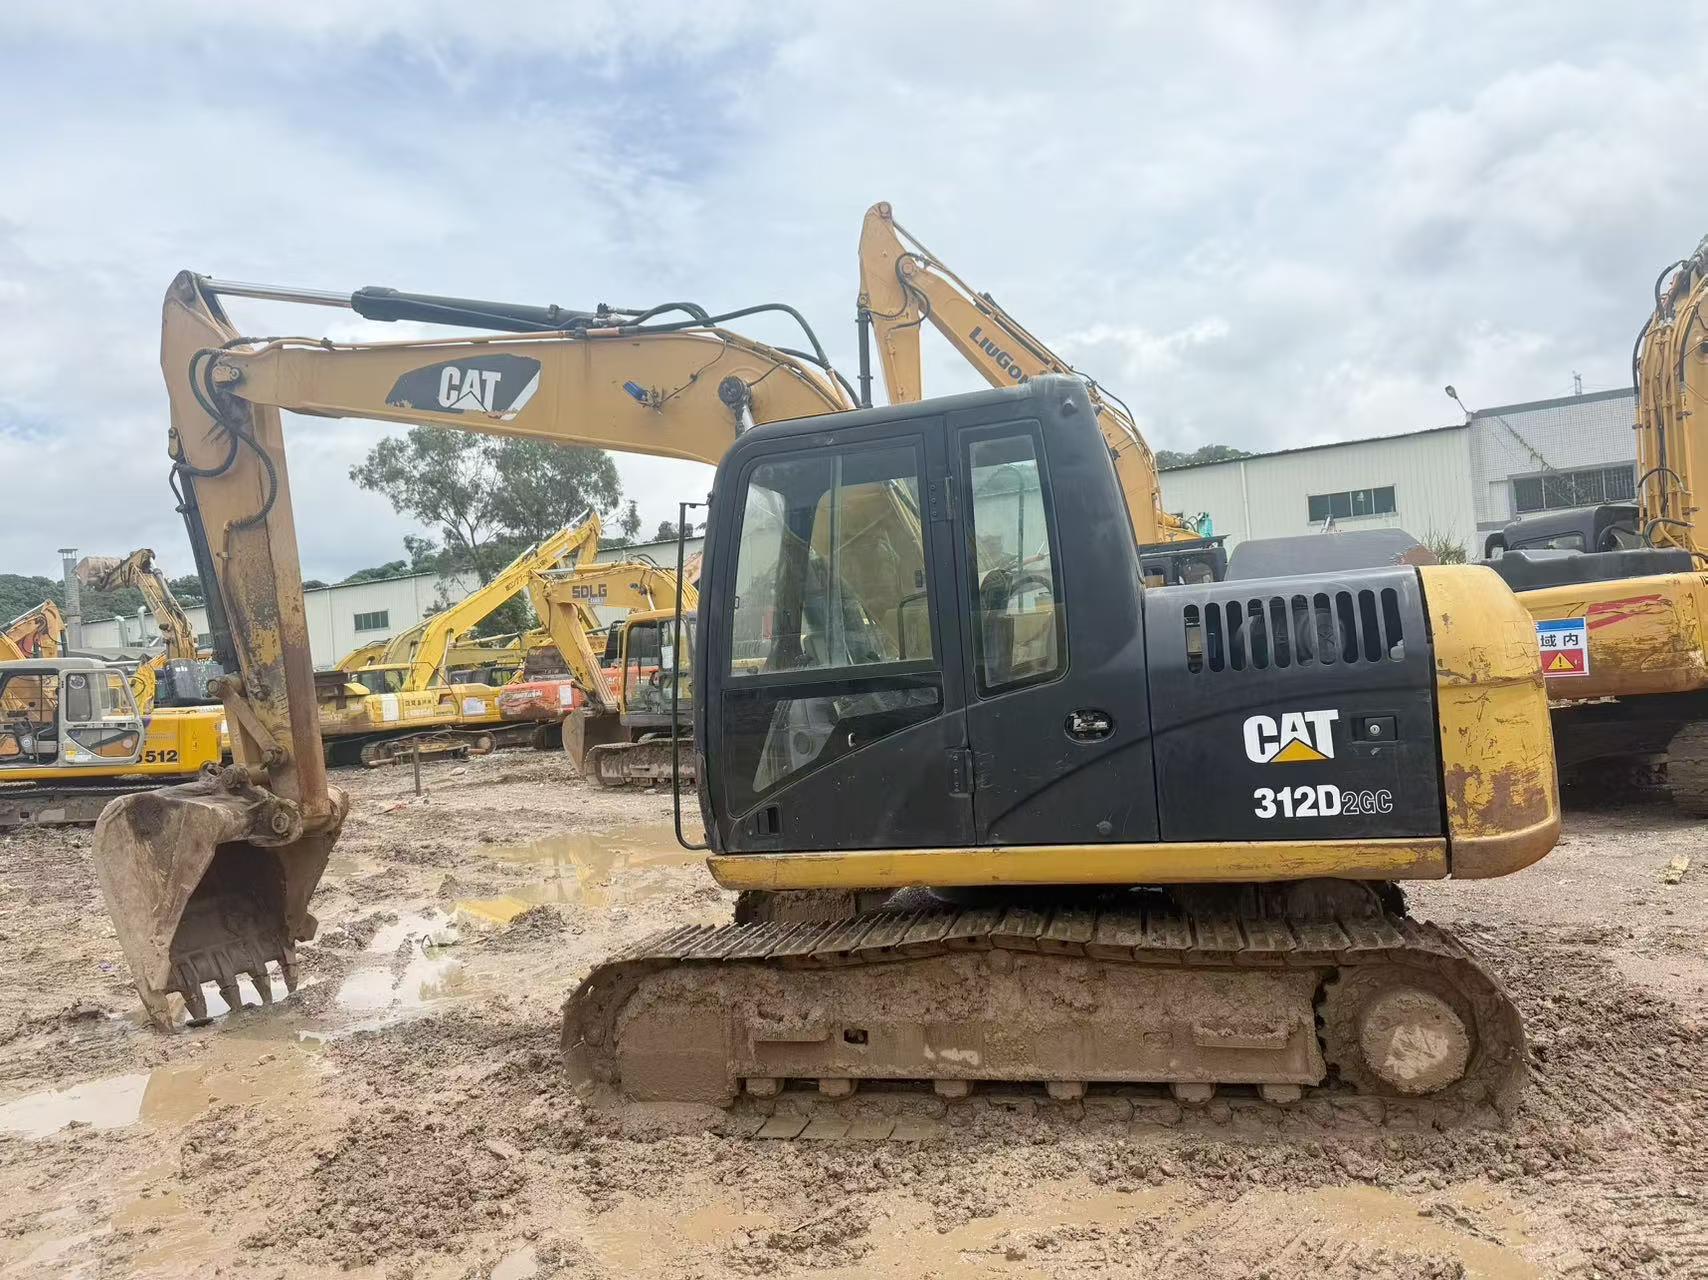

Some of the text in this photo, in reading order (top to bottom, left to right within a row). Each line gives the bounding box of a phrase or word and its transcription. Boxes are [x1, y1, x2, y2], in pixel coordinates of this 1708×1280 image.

[438, 366, 502, 412] CAT
[572, 583, 608, 599] SDLG
[1540, 633, 1579, 648] 域内
[1243, 709, 1339, 764] CAT
